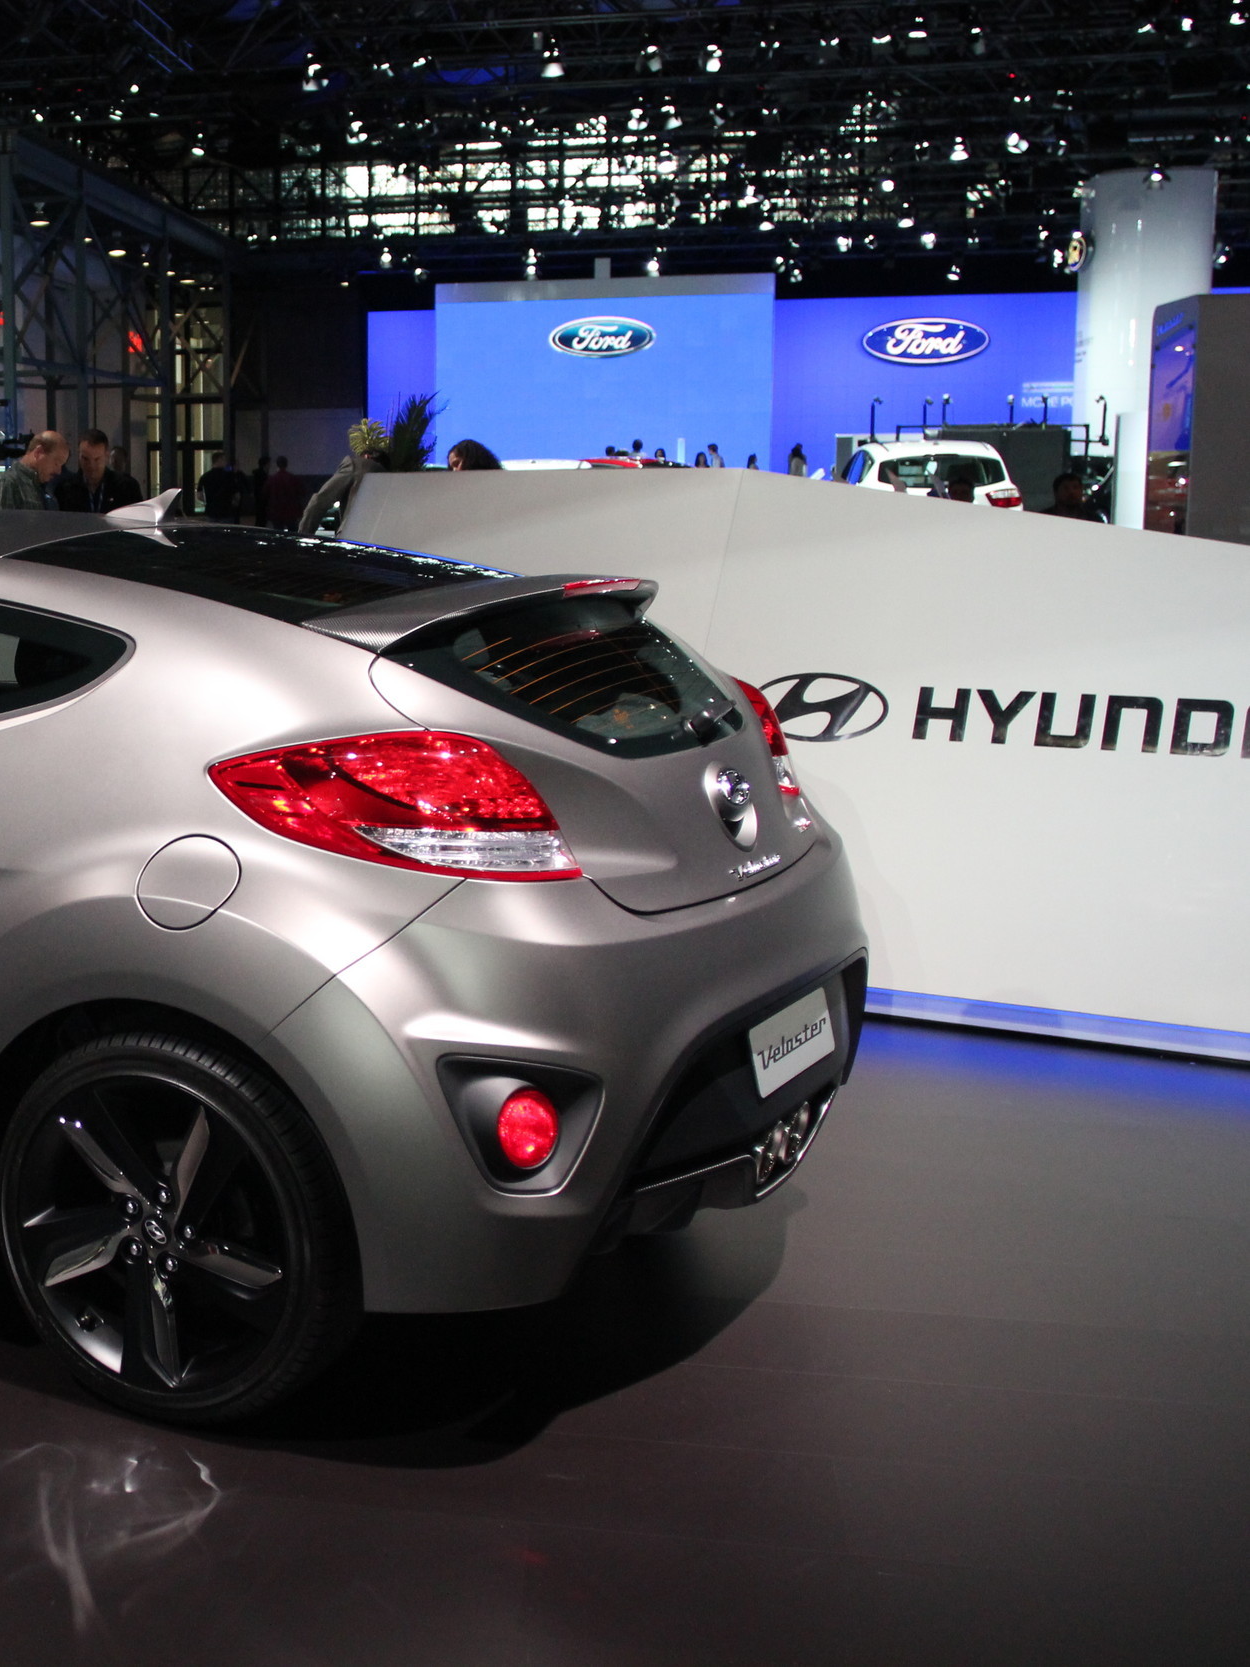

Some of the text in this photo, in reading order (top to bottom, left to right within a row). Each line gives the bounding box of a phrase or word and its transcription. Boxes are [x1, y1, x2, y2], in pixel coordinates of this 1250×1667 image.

[572, 324, 633, 350] Ford
[886, 323, 965, 355] Ford
[912, 686, 1250, 759] HYUND
[757, 1017, 827, 1070] Veloster
